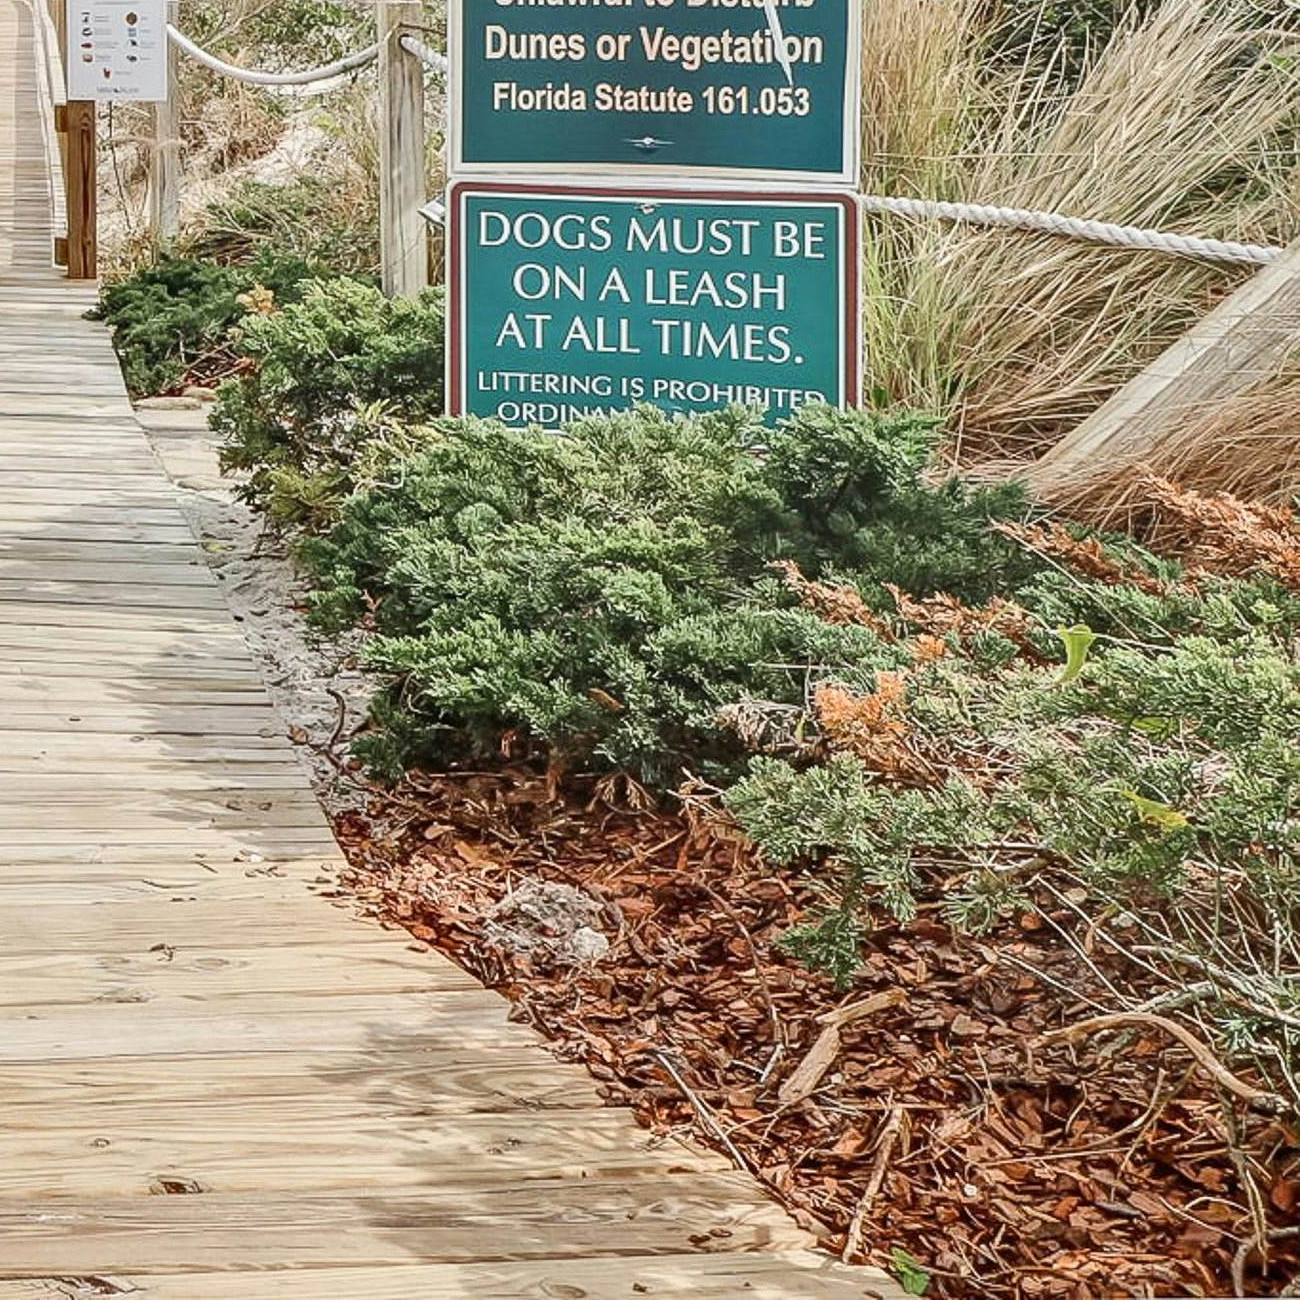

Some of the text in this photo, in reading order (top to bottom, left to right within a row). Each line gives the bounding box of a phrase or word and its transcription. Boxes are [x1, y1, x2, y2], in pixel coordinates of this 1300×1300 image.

[484, 25, 823, 71] Dunes or Vegetation
[493, 82, 811, 116] Florida Statute 161.053
[478, 210, 826, 260] DOGS MUST BE
[512, 262, 786, 311] ON A LEASH
[495, 312, 805, 365] AT ALL TIMES.
[478, 371, 613, 397] LITTERING
[621, 377, 645, 399] IS
